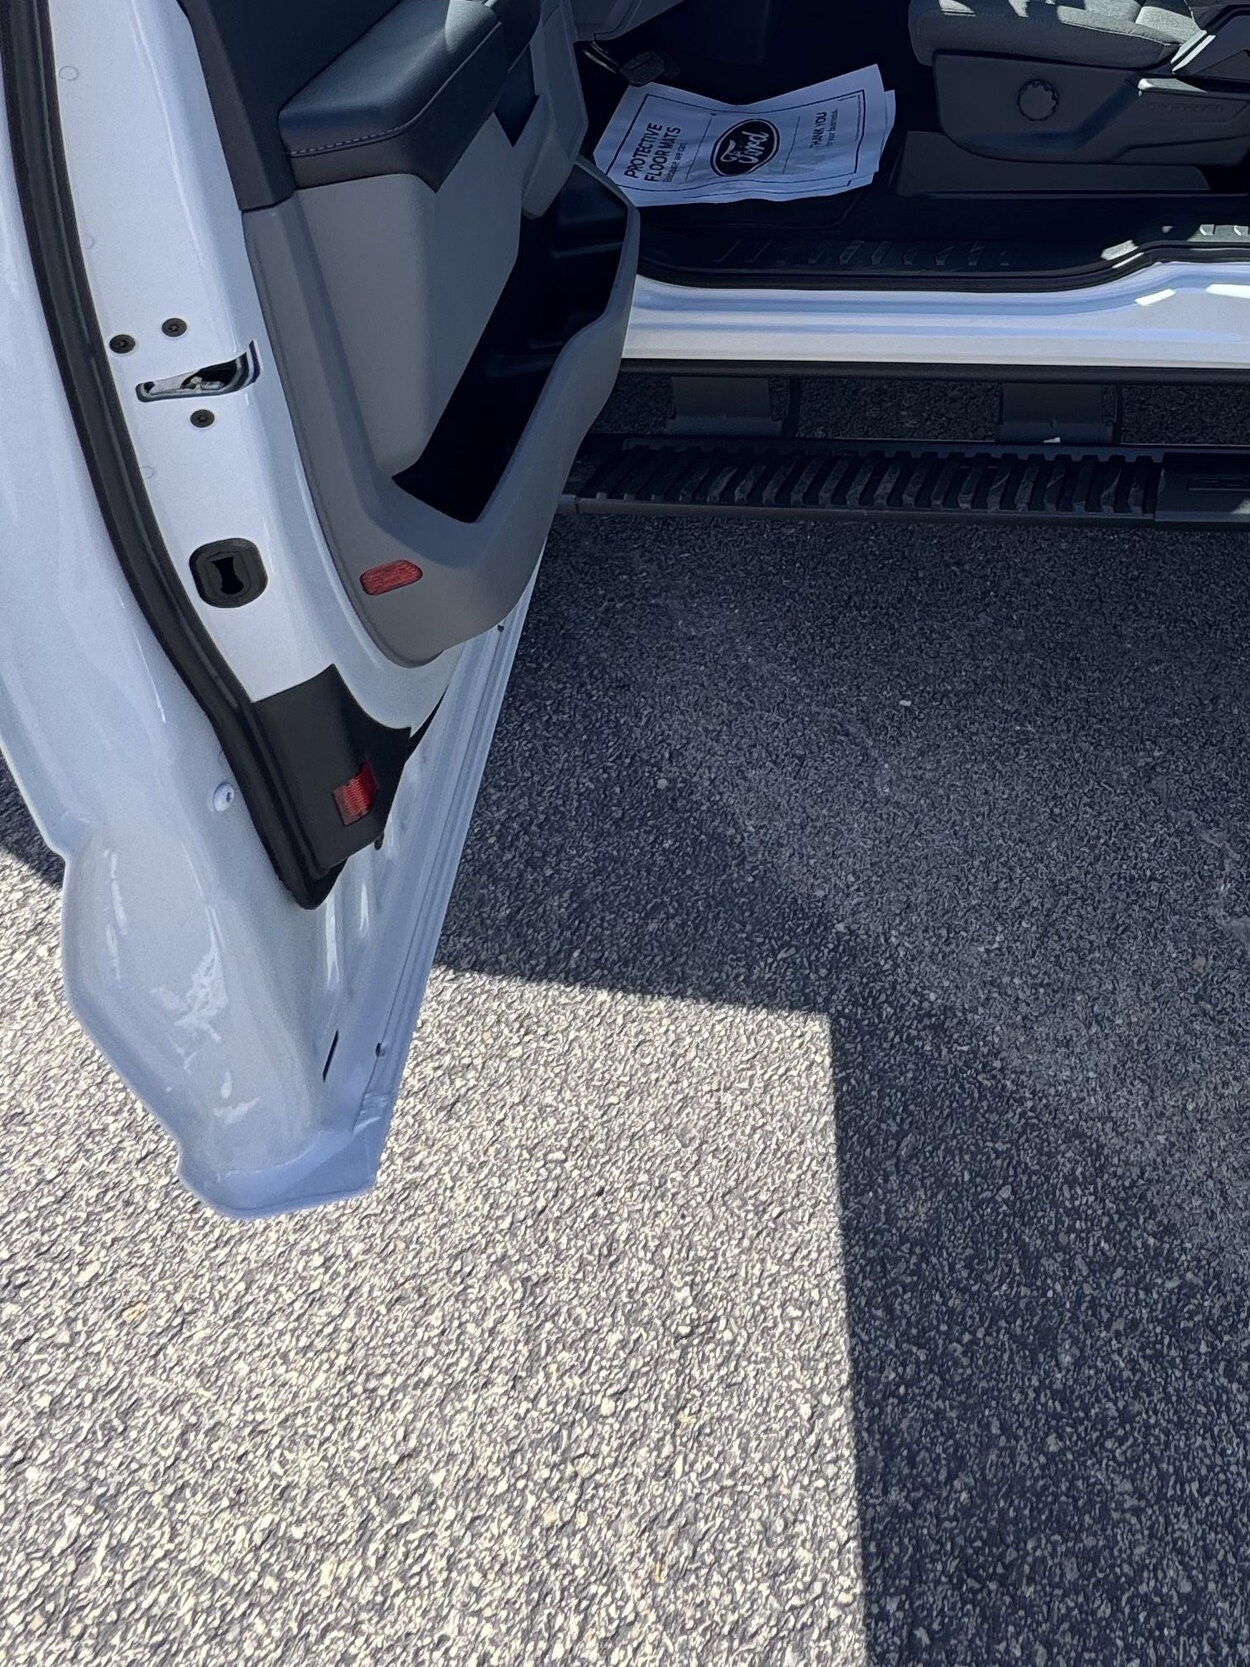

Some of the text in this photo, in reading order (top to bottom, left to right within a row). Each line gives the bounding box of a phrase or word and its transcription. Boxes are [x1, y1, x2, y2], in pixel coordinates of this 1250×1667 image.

[814, 111, 827, 128] YOU
[623, 122, 662, 179] PROTECTIVE
[643, 125, 681, 182] FLOOR MATS
[720, 131, 770, 164] Ford
